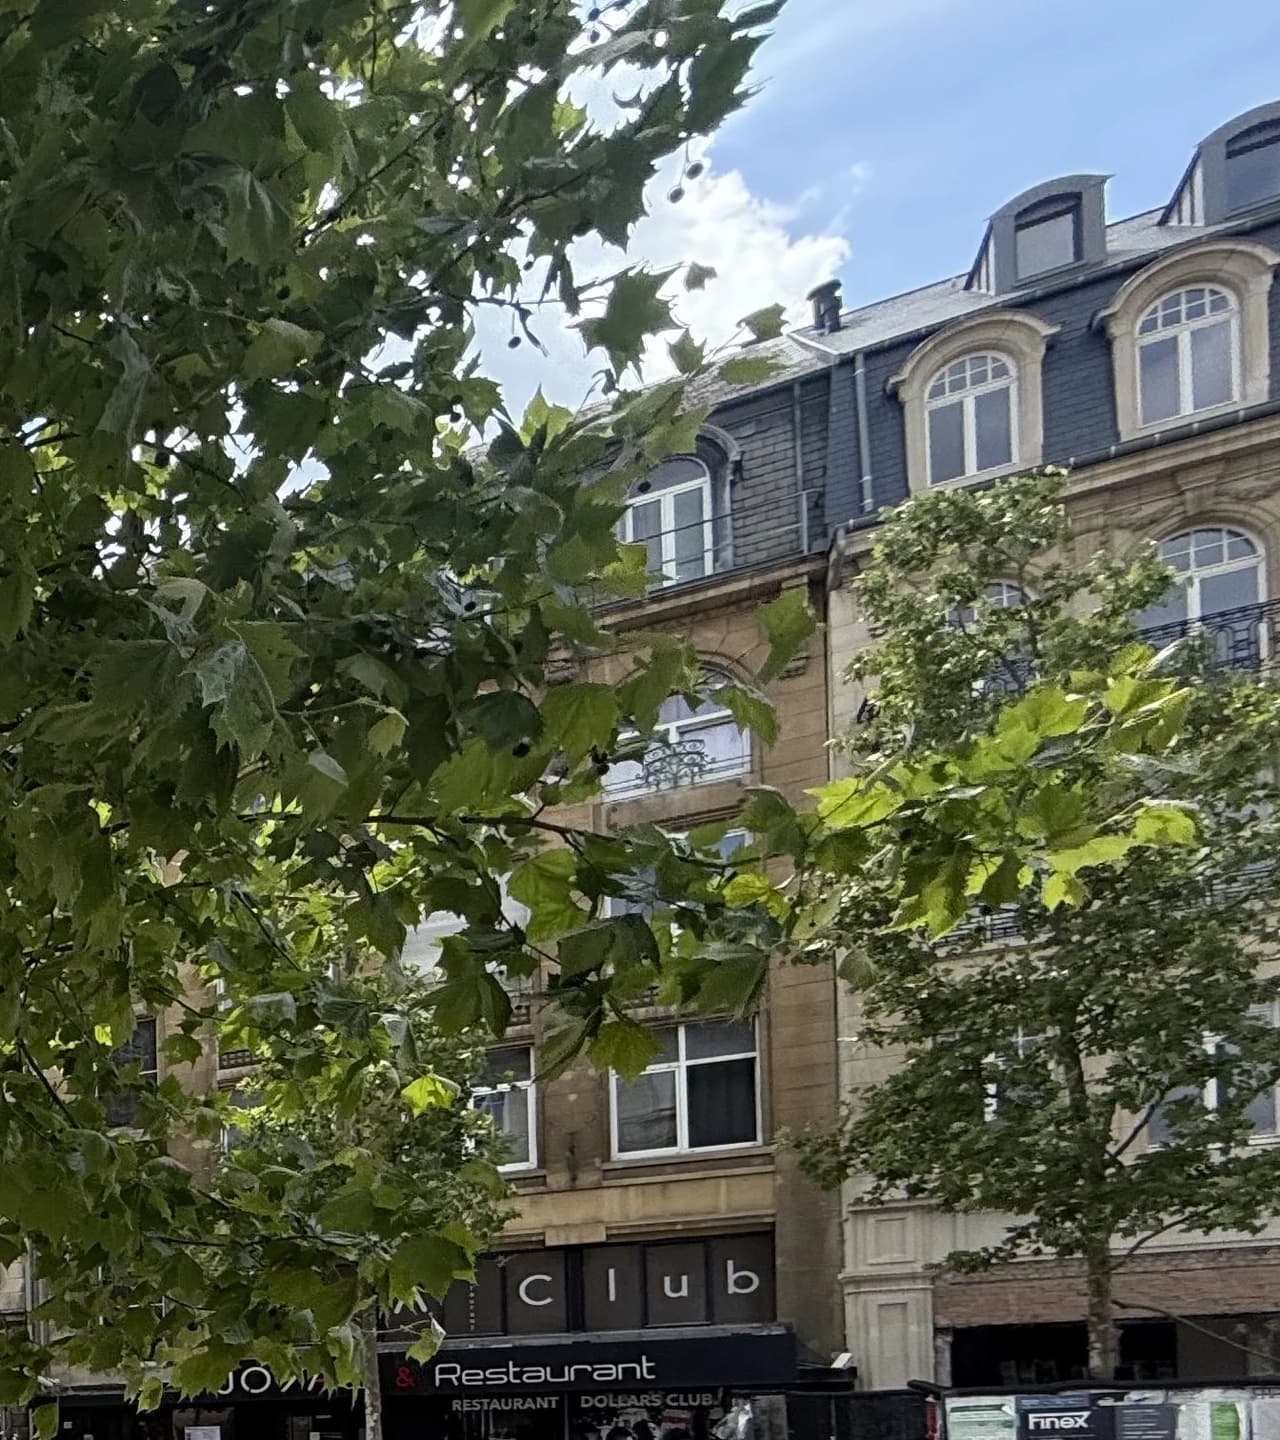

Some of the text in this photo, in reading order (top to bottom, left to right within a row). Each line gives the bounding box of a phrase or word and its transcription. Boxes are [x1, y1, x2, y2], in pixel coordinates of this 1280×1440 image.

[518, 1259, 760, 1306] Club
[395, 1366, 416, 1388] &
[435, 1355, 657, 1387] Restaurant
[451, 1396, 560, 1411] RESTAURANT
[580, 1394, 661, 1408] DOLLARS
